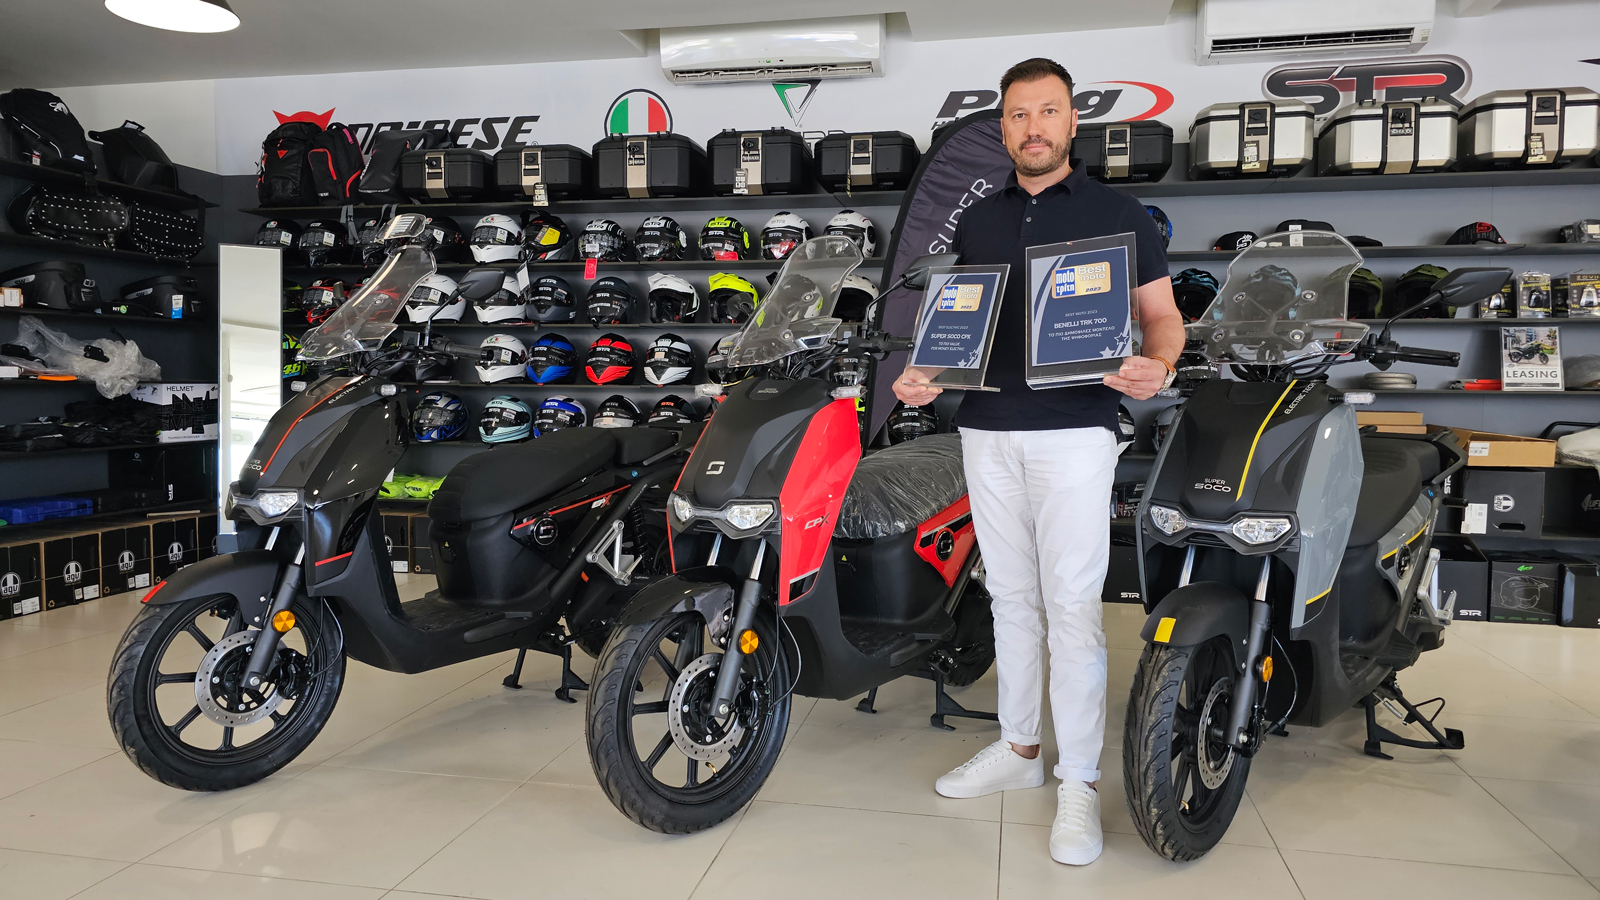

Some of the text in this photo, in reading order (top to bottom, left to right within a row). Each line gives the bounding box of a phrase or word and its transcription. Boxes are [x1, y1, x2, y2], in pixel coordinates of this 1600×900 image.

[1264, 58, 1467, 116] STR
[928, 178, 993, 255] SUPER
[1078, 263, 1107, 275] Best
[1056, 270, 1075, 284] moto
[1080, 272, 1106, 281] moto
[943, 288, 958, 299] moto
[1054, 320, 1079, 329] BENELLI
[1506, 370, 1558, 379] LEASING
[1284, 382, 1316, 414] ELECTRIC TECH
[1204, 477, 1226, 486] SUPER
[1194, 482, 1232, 493] SOCO
[804, 513, 830, 530] CPX
[1120, 592, 1140, 600] STR
[1459, 609, 1482, 617] STR
